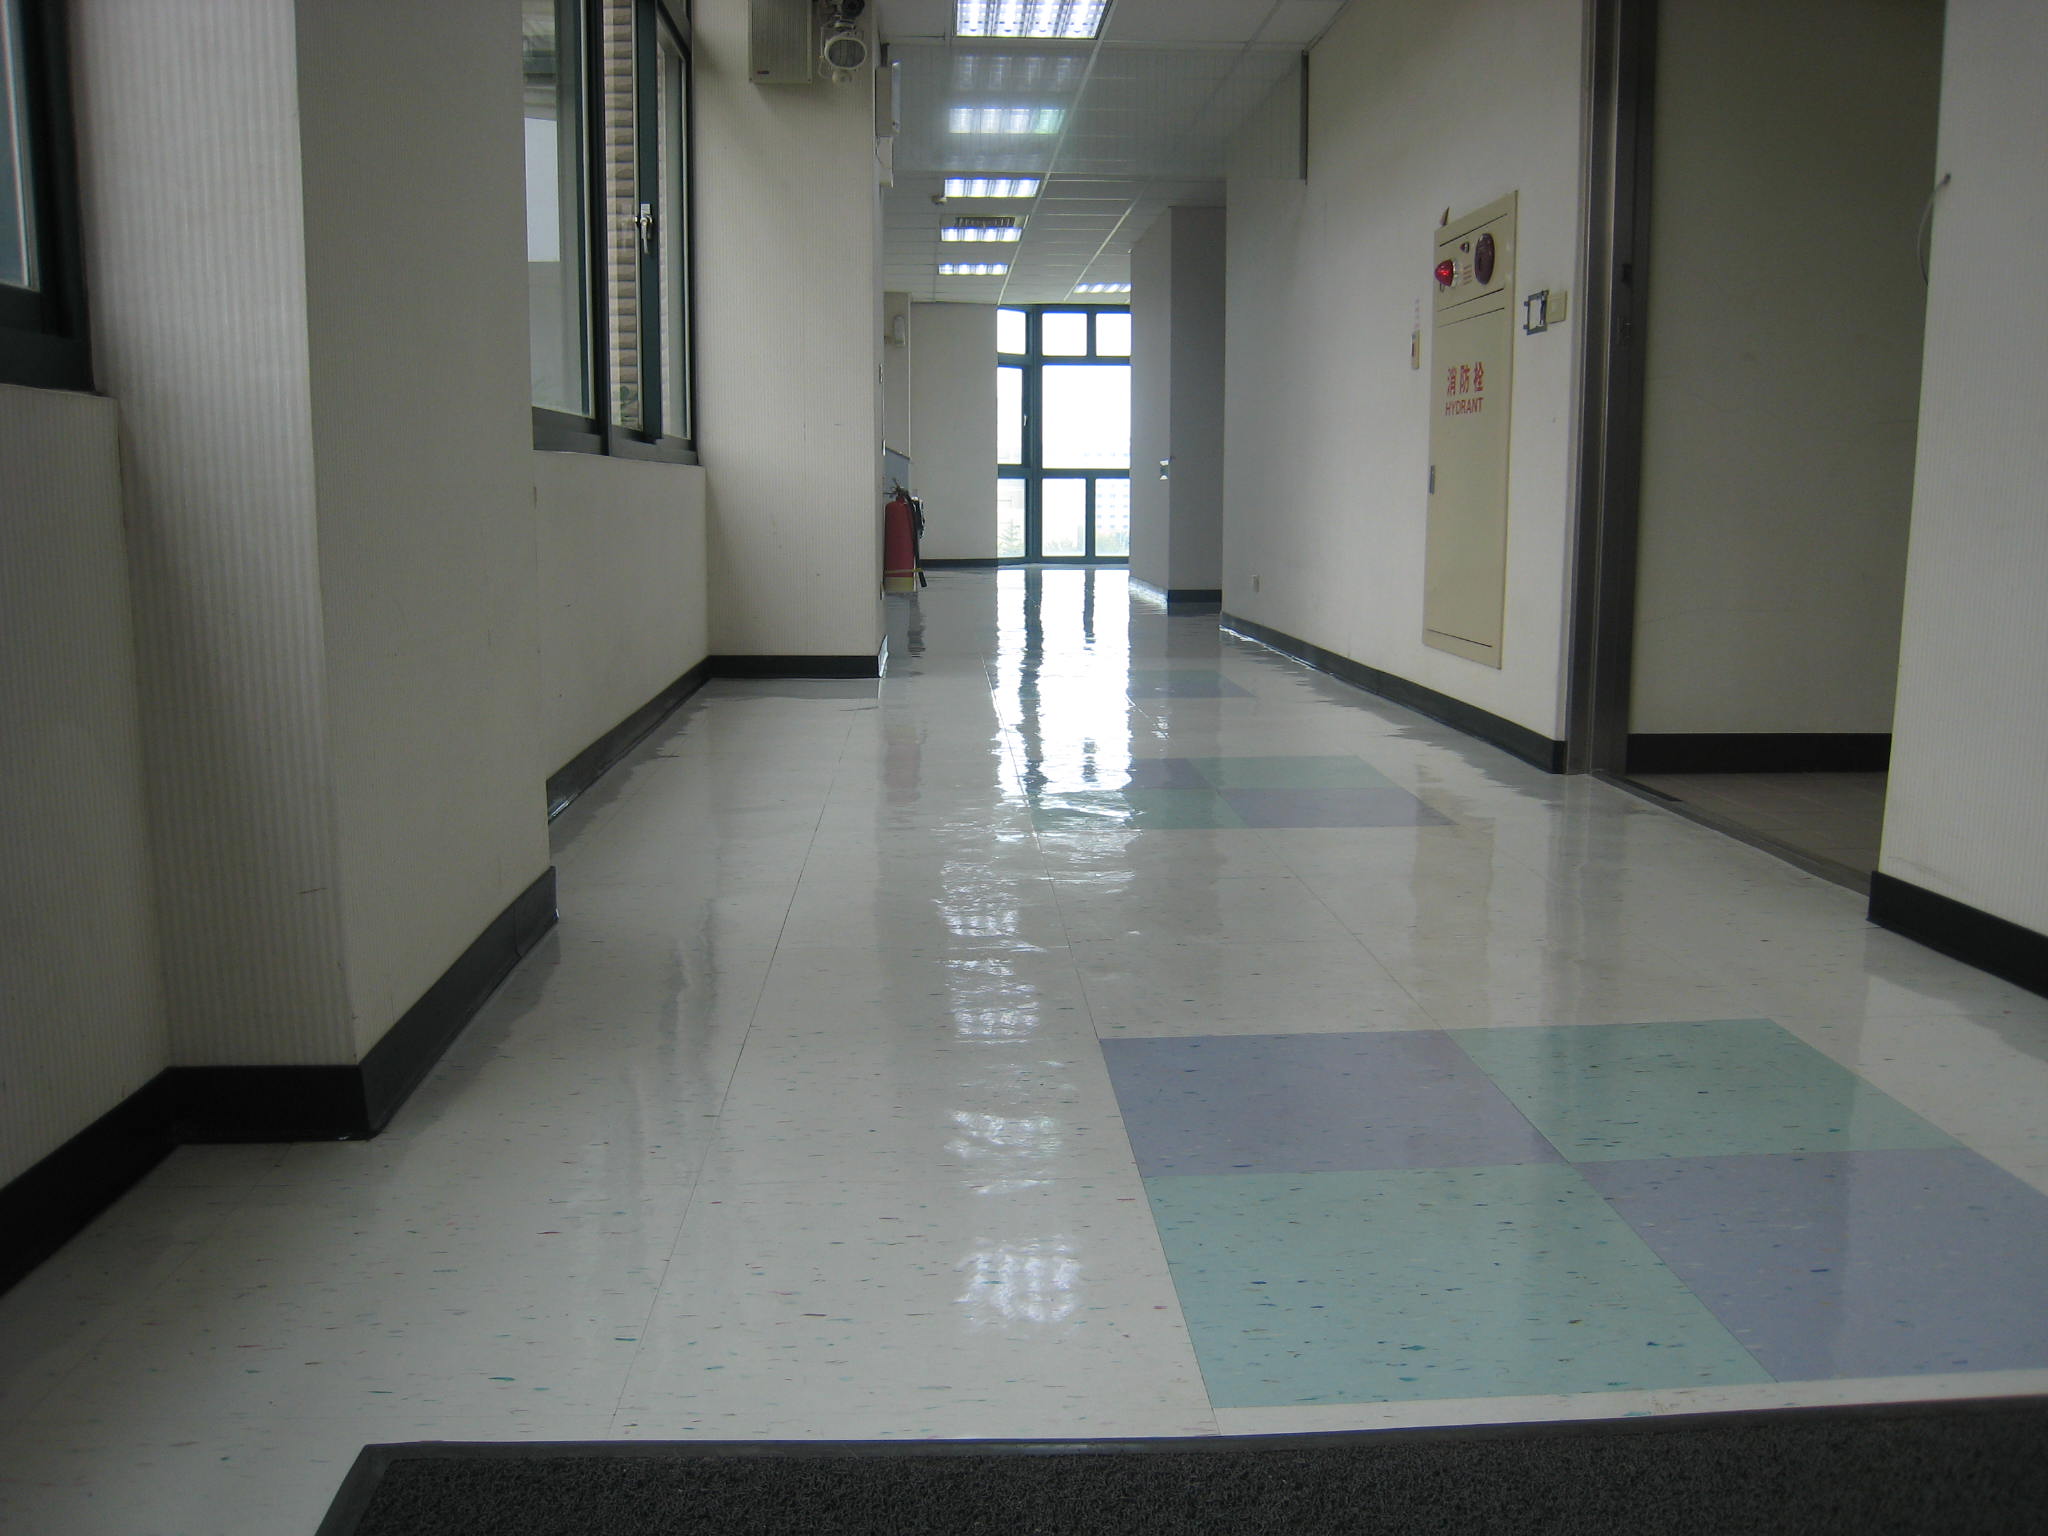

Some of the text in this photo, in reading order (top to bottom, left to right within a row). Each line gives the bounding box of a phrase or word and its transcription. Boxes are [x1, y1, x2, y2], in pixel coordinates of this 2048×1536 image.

[1447, 361, 1484, 396] 消防栓
[1445, 397, 1484, 416] HYDRANT
